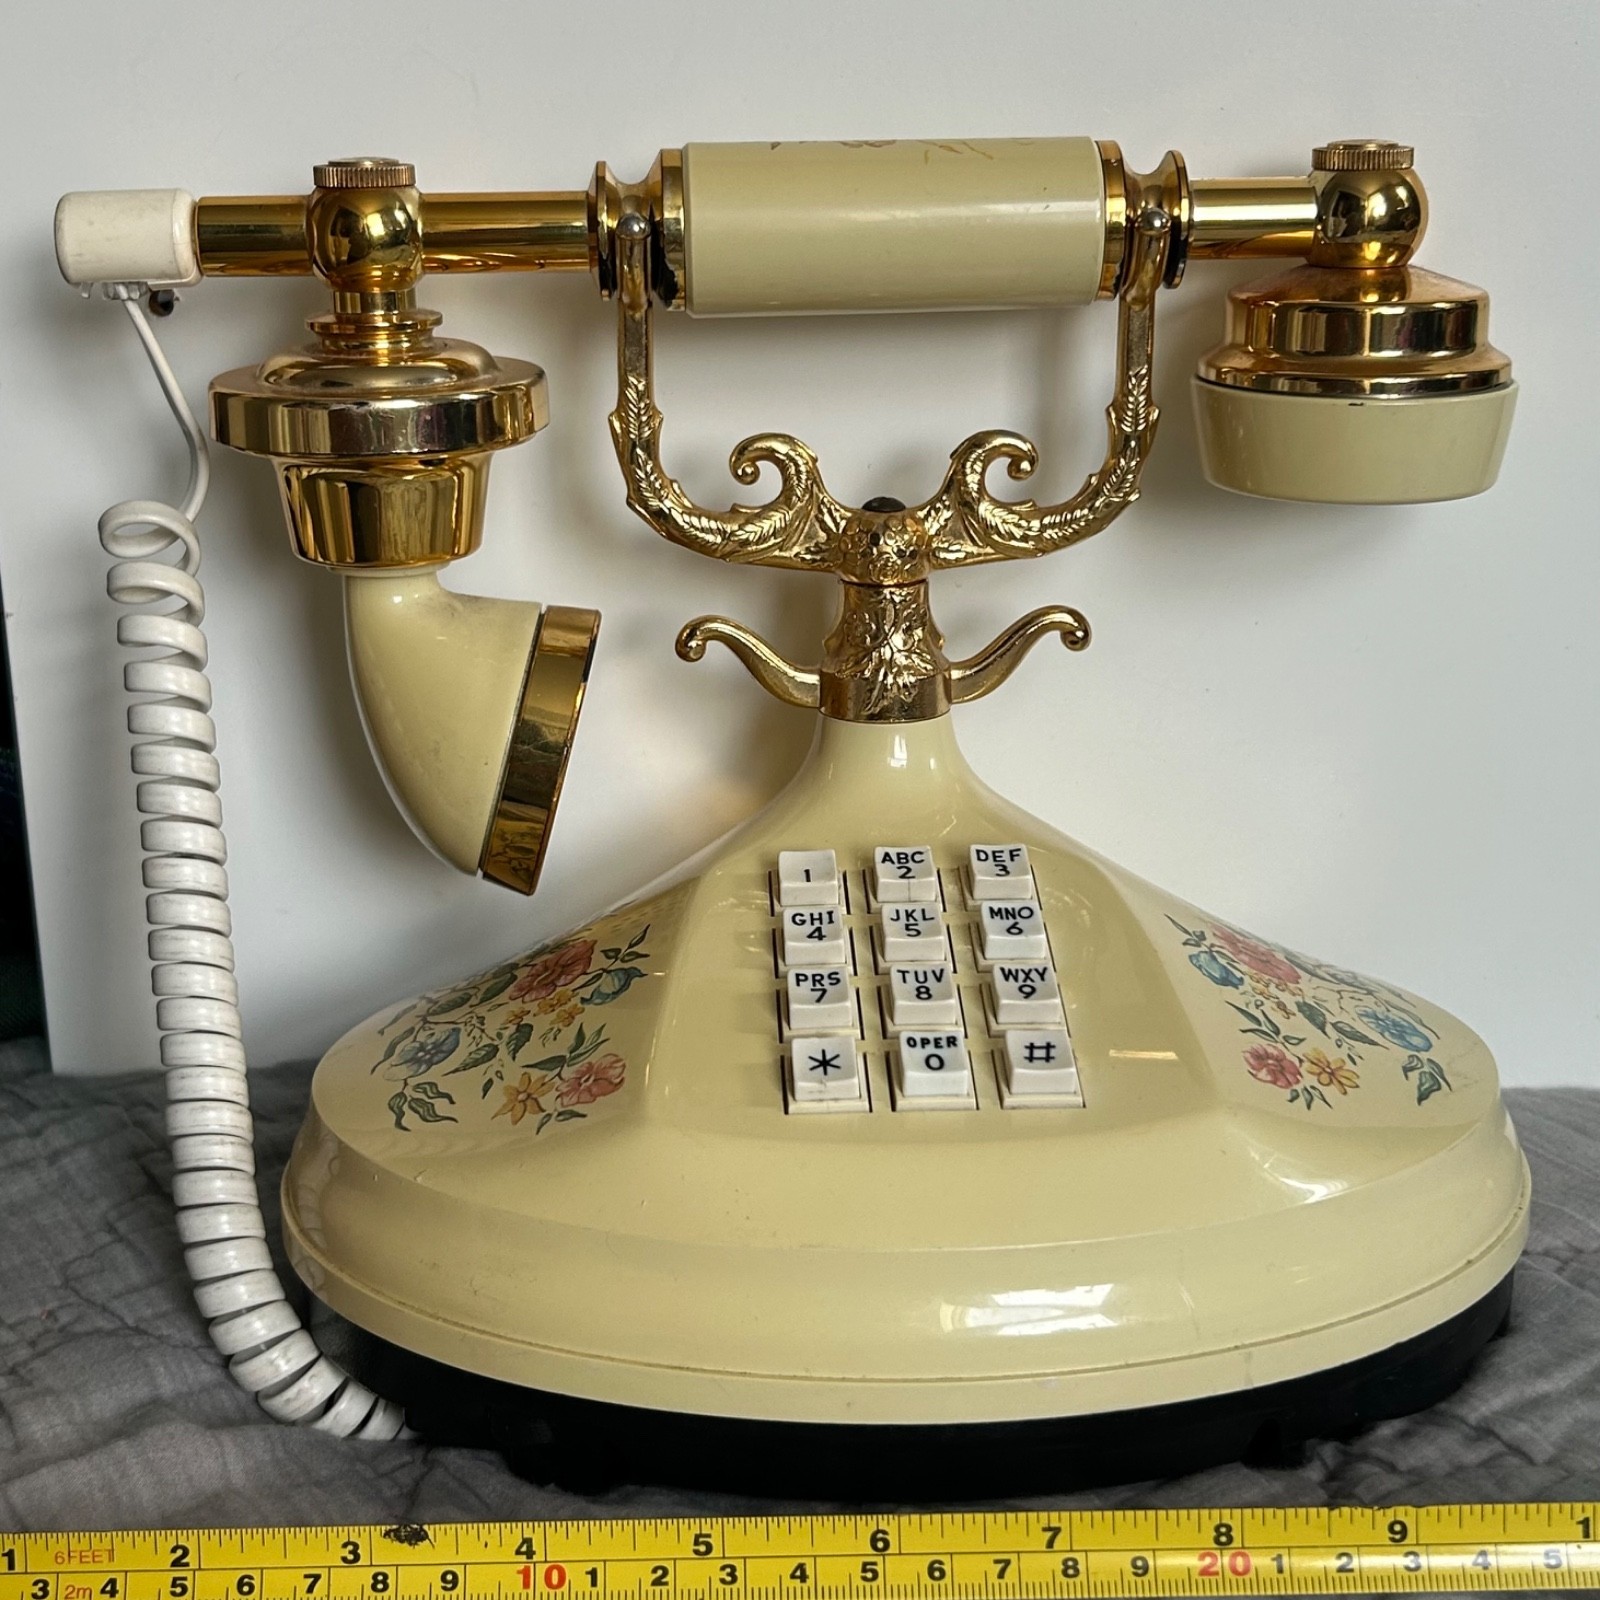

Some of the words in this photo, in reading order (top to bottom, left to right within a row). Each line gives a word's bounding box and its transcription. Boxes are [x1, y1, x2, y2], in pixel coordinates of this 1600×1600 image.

[881, 851, 925, 865] ABC
[975, 848, 1022, 862] DEF
[804, 869, 811, 882] 1
[899, 866, 916, 879] 2
[995, 864, 1010, 877] 3
[791, 911, 834, 926] GHI
[890, 908, 935, 922] JKL
[989, 907, 1034, 920] MNO
[806, 926, 827, 941] 4
[905, 924, 921, 938] 5
[1006, 922, 1023, 936] 6
[795, 972, 841, 986] PRS
[897, 968, 944, 984] TUV
[1000, 967, 1048, 982] WXY
[810, 988, 828, 1003] 7
[915, 986, 932, 1000] 8
[1018, 985, 1036, 999] 9
[906, 1036, 958, 1048] OPER
[869, 1529, 890, 1553] 6
[1042, 1526, 1062, 1549] 7
[1213, 1523, 1233, 1546] 8
[1388, 1520, 1407, 1543] 9
[340, 1541, 361, 1564] 3
[515, 1537, 536, 1560] 4
[692, 1533, 713, 1556] 5
[1, 1549, 15, 1571] 1
[169, 1544, 190, 1568] 2
[1130, 1556, 1149, 1577] 9
[1197, 1551, 1252, 1576] 20
[1271, 1553, 1284, 1574] 1
[1335, 1552, 1354, 1573] 2
[1403, 1551, 1422, 1572] 3
[1472, 1549, 1491, 1570] 4
[1544, 1549, 1563, 1569] 5
[517, 1564, 566, 1590] 10
[585, 1567, 598, 1588] 1
[650, 1565, 669, 1587] 2
[719, 1564, 738, 1585] 3
[789, 1562, 809, 1583] 4
[860, 1561, 879, 1582] 5
[927, 1559, 946, 1581] 6
[993, 1559, 1011, 1579] 7
[1061, 1557, 1080, 1578] 8
[31, 1579, 50, 1600] 3
[100, 1577, 119, 1599] 4
[170, 1575, 189, 1597] 5
[236, 1574, 255, 1596] 6
[303, 1574, 322, 1594] 7
[370, 1571, 389, 1593] 8
[440, 1570, 459, 1591] 9
